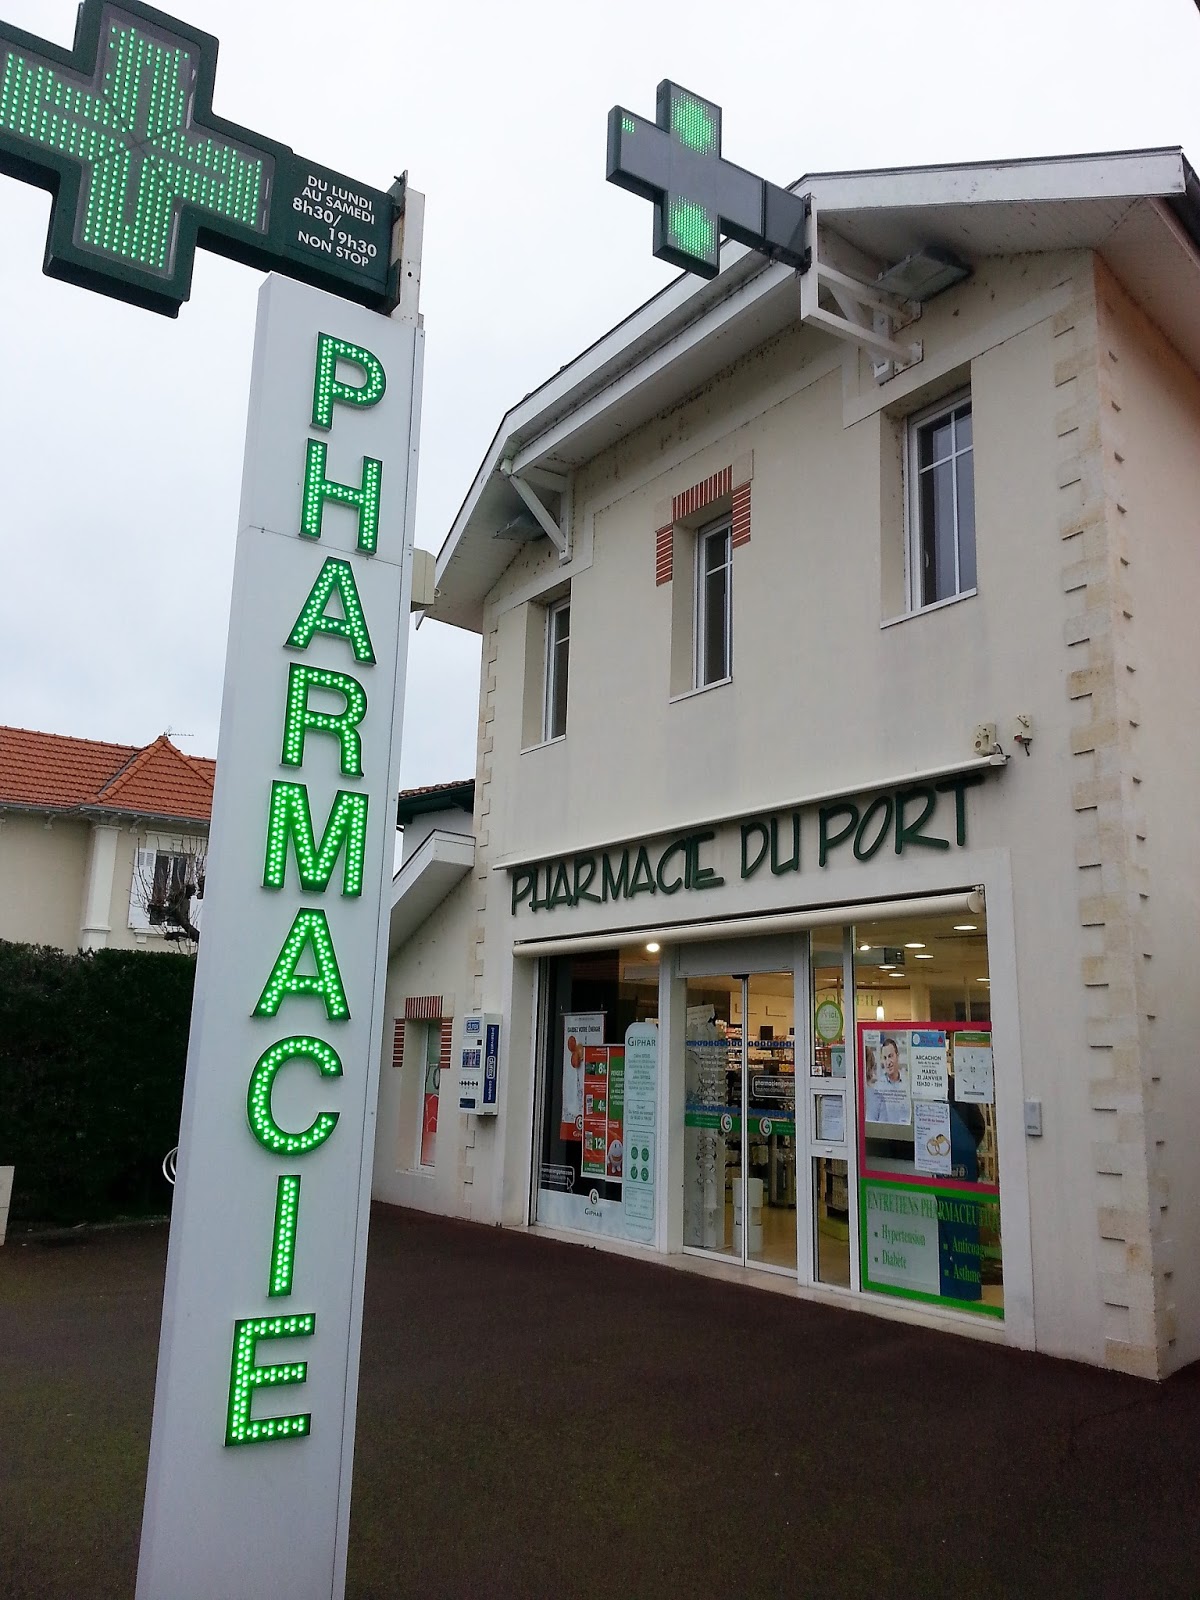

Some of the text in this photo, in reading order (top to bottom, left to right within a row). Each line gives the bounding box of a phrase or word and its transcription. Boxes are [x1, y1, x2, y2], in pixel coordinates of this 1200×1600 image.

[301, 186, 375, 225] AU SAMEDI
[307, 175, 373, 211] DU LUNDI
[292, 197, 342, 227] 8h30/
[297, 231, 369, 267] NON STOP
[511, 774, 986, 916] PHARMACIE DU PORT
[223, 331, 387, 1447] PHARMACIE
[627, 1036, 656, 1047] GIPHAR
[867, 1190, 919, 1216] ENTRETIENS
[881, 1224, 926, 1246] Hypertension
[953, 1263, 981, 1283] Asthme
